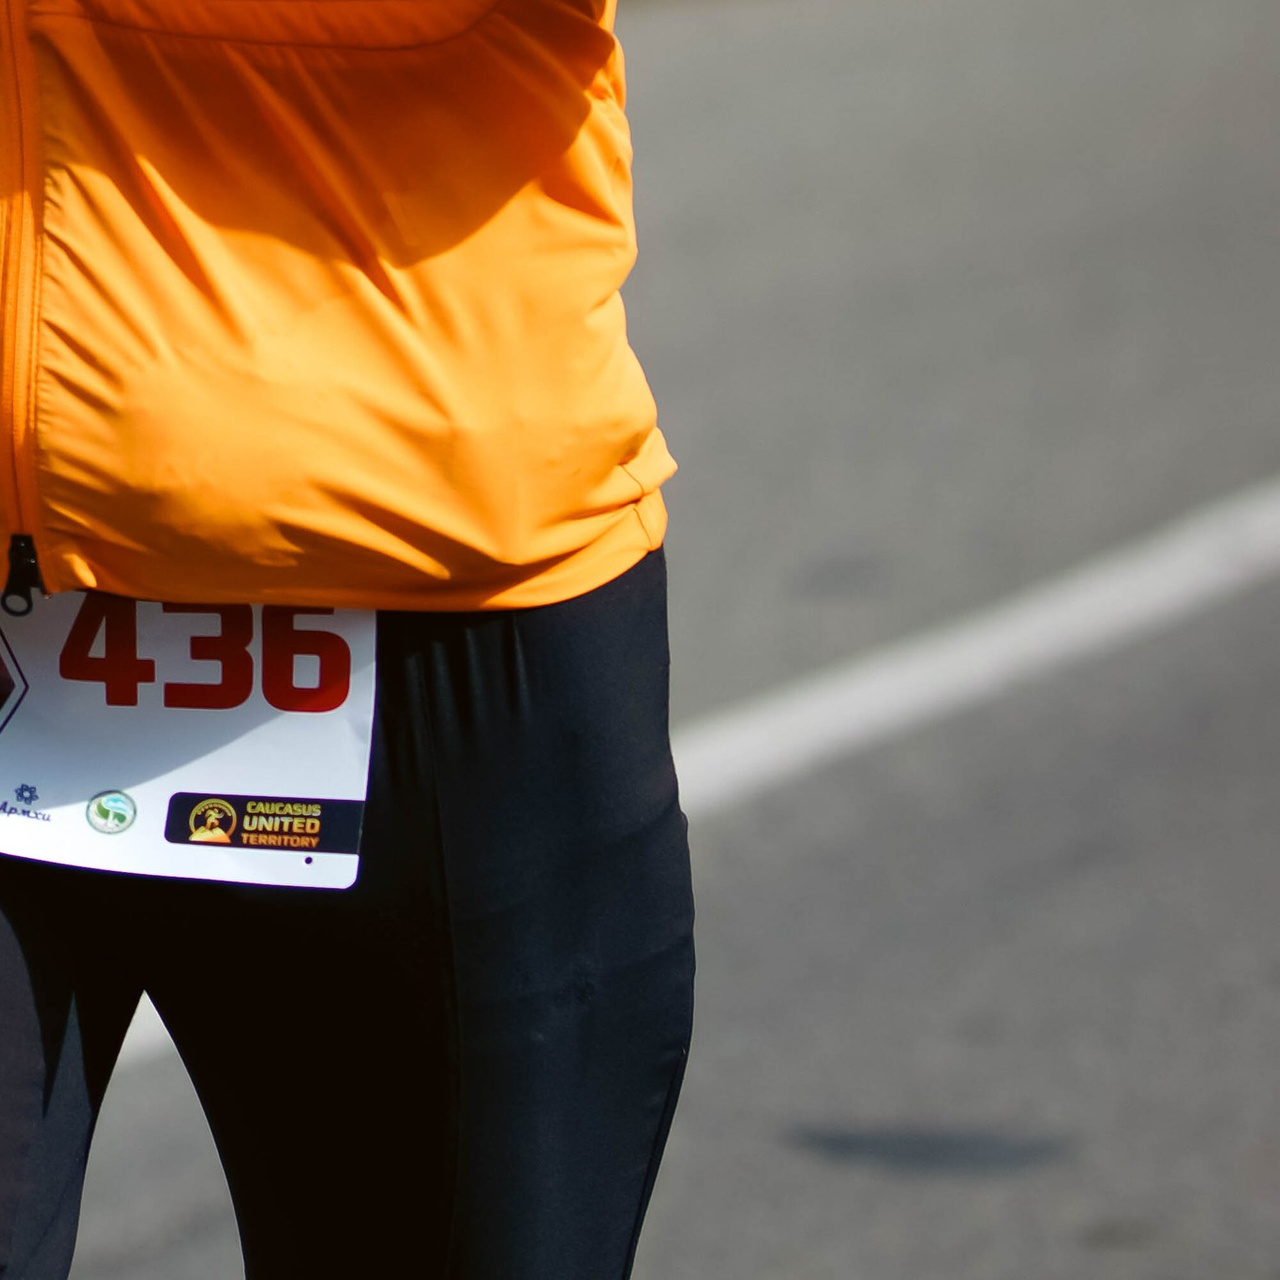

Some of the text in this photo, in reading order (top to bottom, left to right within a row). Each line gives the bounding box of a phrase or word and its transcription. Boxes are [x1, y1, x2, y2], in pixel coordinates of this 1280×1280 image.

[58, 592, 352, 713] 436
[246, 800, 322, 817] CAUCASUS
[243, 815, 321, 835] UNITED
[240, 832, 321, 849] TERRITORY
